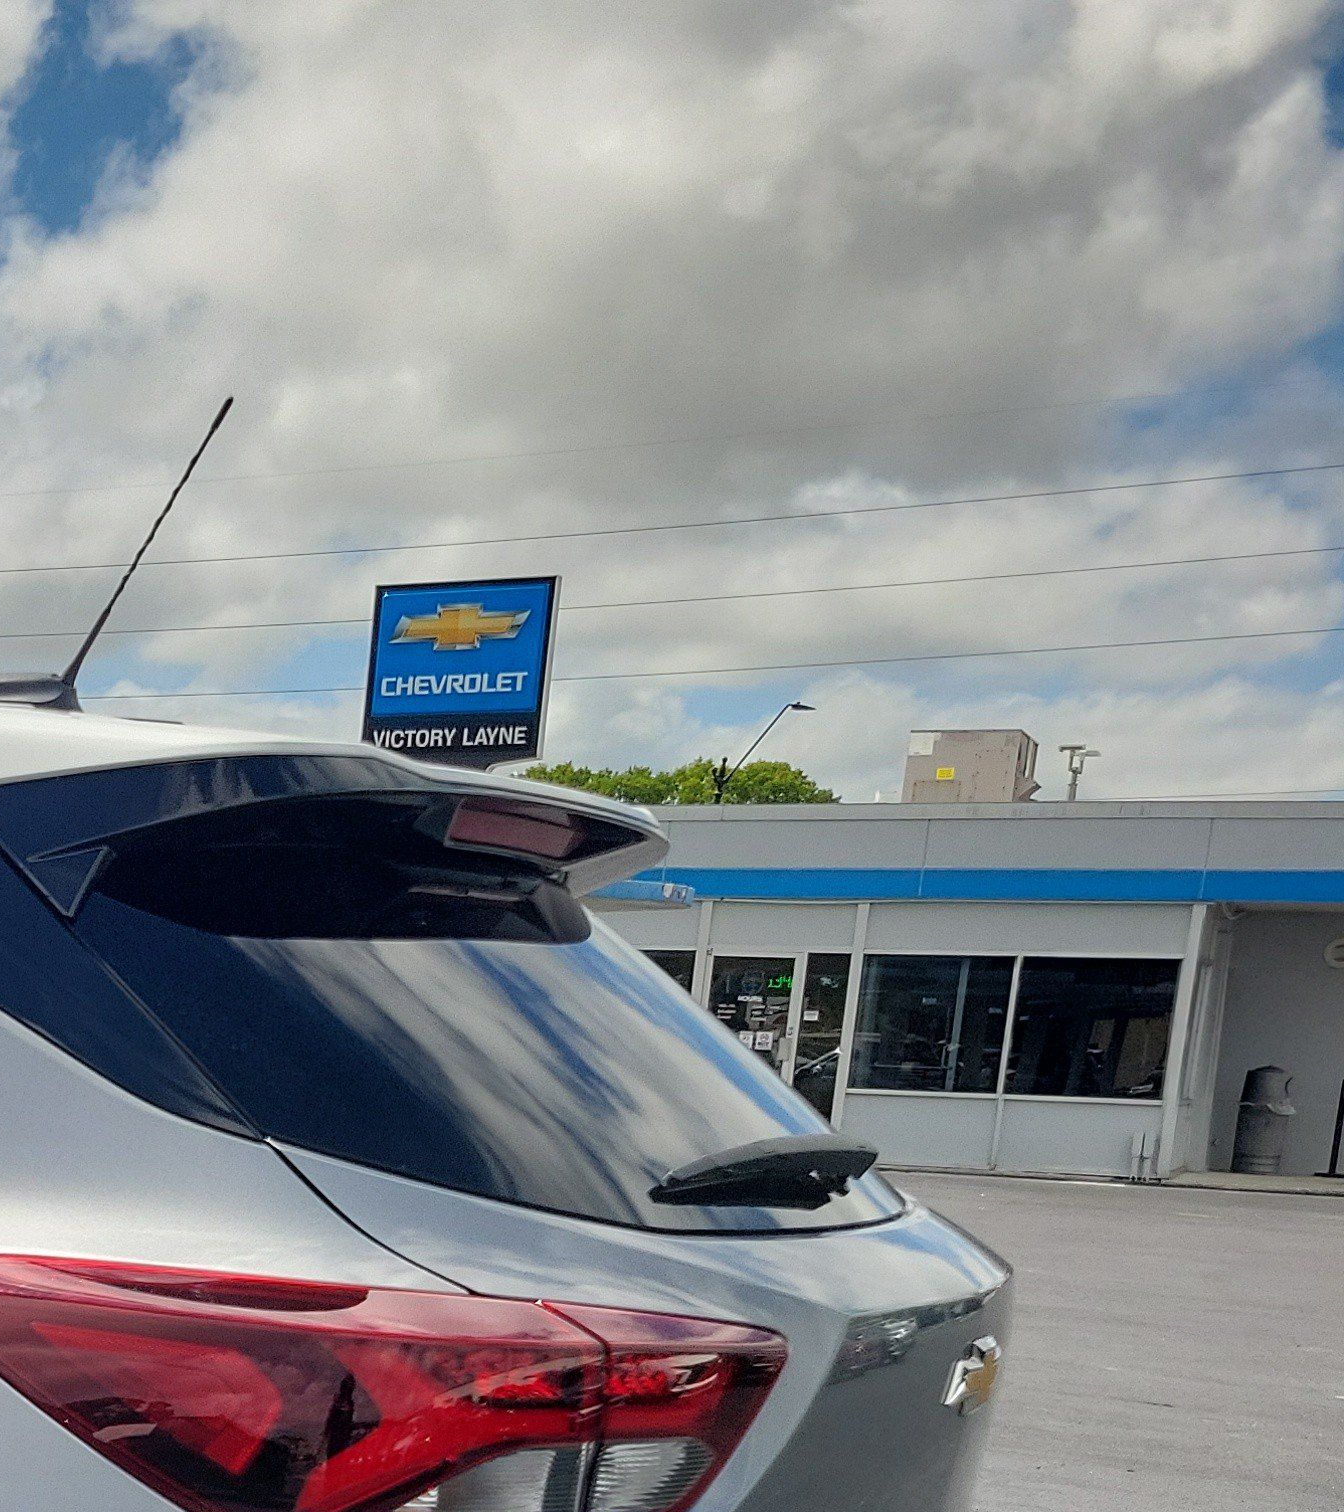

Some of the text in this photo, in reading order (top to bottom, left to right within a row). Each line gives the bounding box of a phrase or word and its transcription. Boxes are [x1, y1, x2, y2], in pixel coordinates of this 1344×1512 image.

[381, 671, 528, 697] CHEVROLET
[373, 724, 528, 748] VICTORY LAYNE
